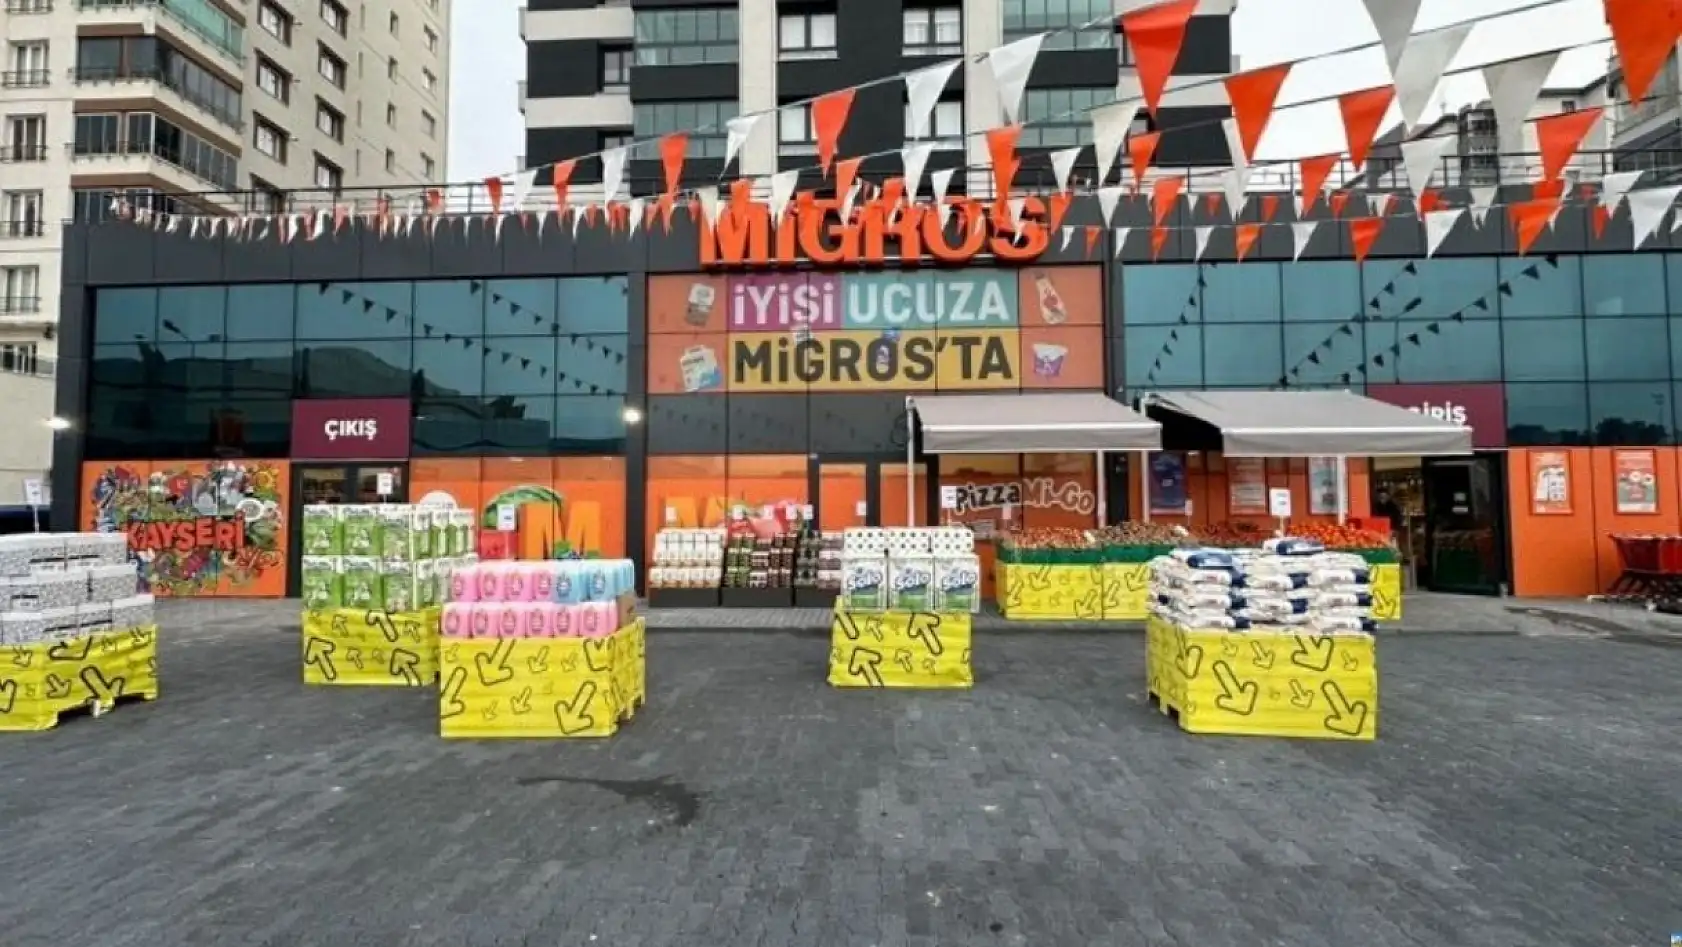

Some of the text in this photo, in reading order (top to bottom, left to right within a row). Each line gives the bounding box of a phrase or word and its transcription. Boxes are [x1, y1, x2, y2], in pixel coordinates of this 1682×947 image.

[849, 281, 1010, 324] UCUZA
[324, 419, 378, 441] ÇIKIŞ
[955, 483, 1021, 512] Pizza
[122, 510, 245, 552] KAYSERİ
